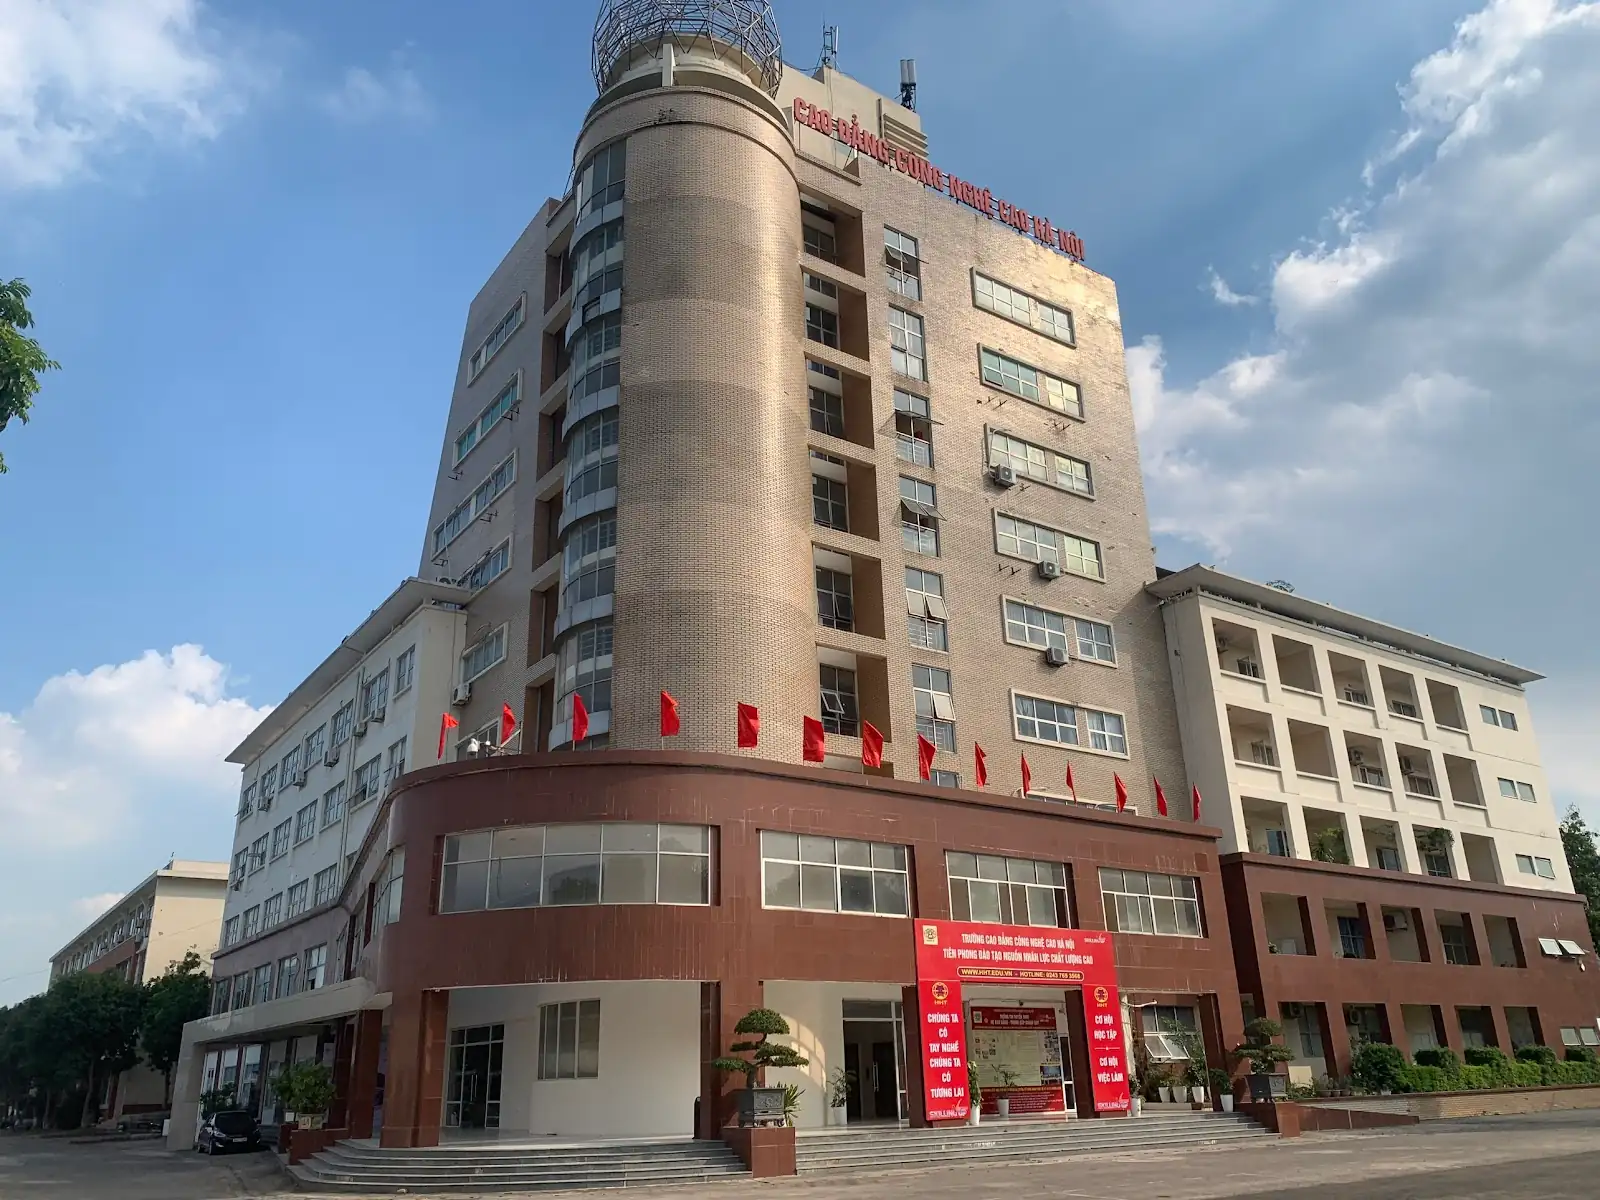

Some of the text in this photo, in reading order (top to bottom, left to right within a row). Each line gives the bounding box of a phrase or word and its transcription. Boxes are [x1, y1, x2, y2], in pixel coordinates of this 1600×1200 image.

[793, 97, 1085, 262] CAO ĐẲNG CÔNG NGHỆ CAO HÀ NỘI
[961, 931, 1075, 951] TRƯỜNG CAO ĐẲNG CÔNG NGHỆ CAO HÀ NỘI
[957, 949, 978, 960] PHONG
[978, 948, 991, 960] ĐÀO
[991, 951, 1003, 963] TẠO
[1023, 950, 1039, 963] NHÂN
[1039, 953, 1050, 964] LỰC
[1051, 951, 1065, 964] CHẤT
[1065, 954, 1082, 966] LƯỢNG
[1083, 955, 1094, 965] CAO
[961, 968, 1013, 977] WWW.HHT.EDU.VN
[927, 1012, 959, 1024] CHÚNG TA
[1094, 1014, 1114, 1026] CƠ HỘI
[938, 1026, 948, 1038] CÓ
[1093, 1029, 1117, 1041] HỌC TẬP
[929, 1042, 940, 1053] TAY
[930, 1056, 962, 1068] CHÚNG TA
[1099, 1055, 1119, 1068] CƠ HỘI
[941, 1070, 952, 1083] CÓ
[1097, 1071, 1124, 1085] VIỆC LÀM
[930, 1086, 964, 1098] TƯƠNG LAI
